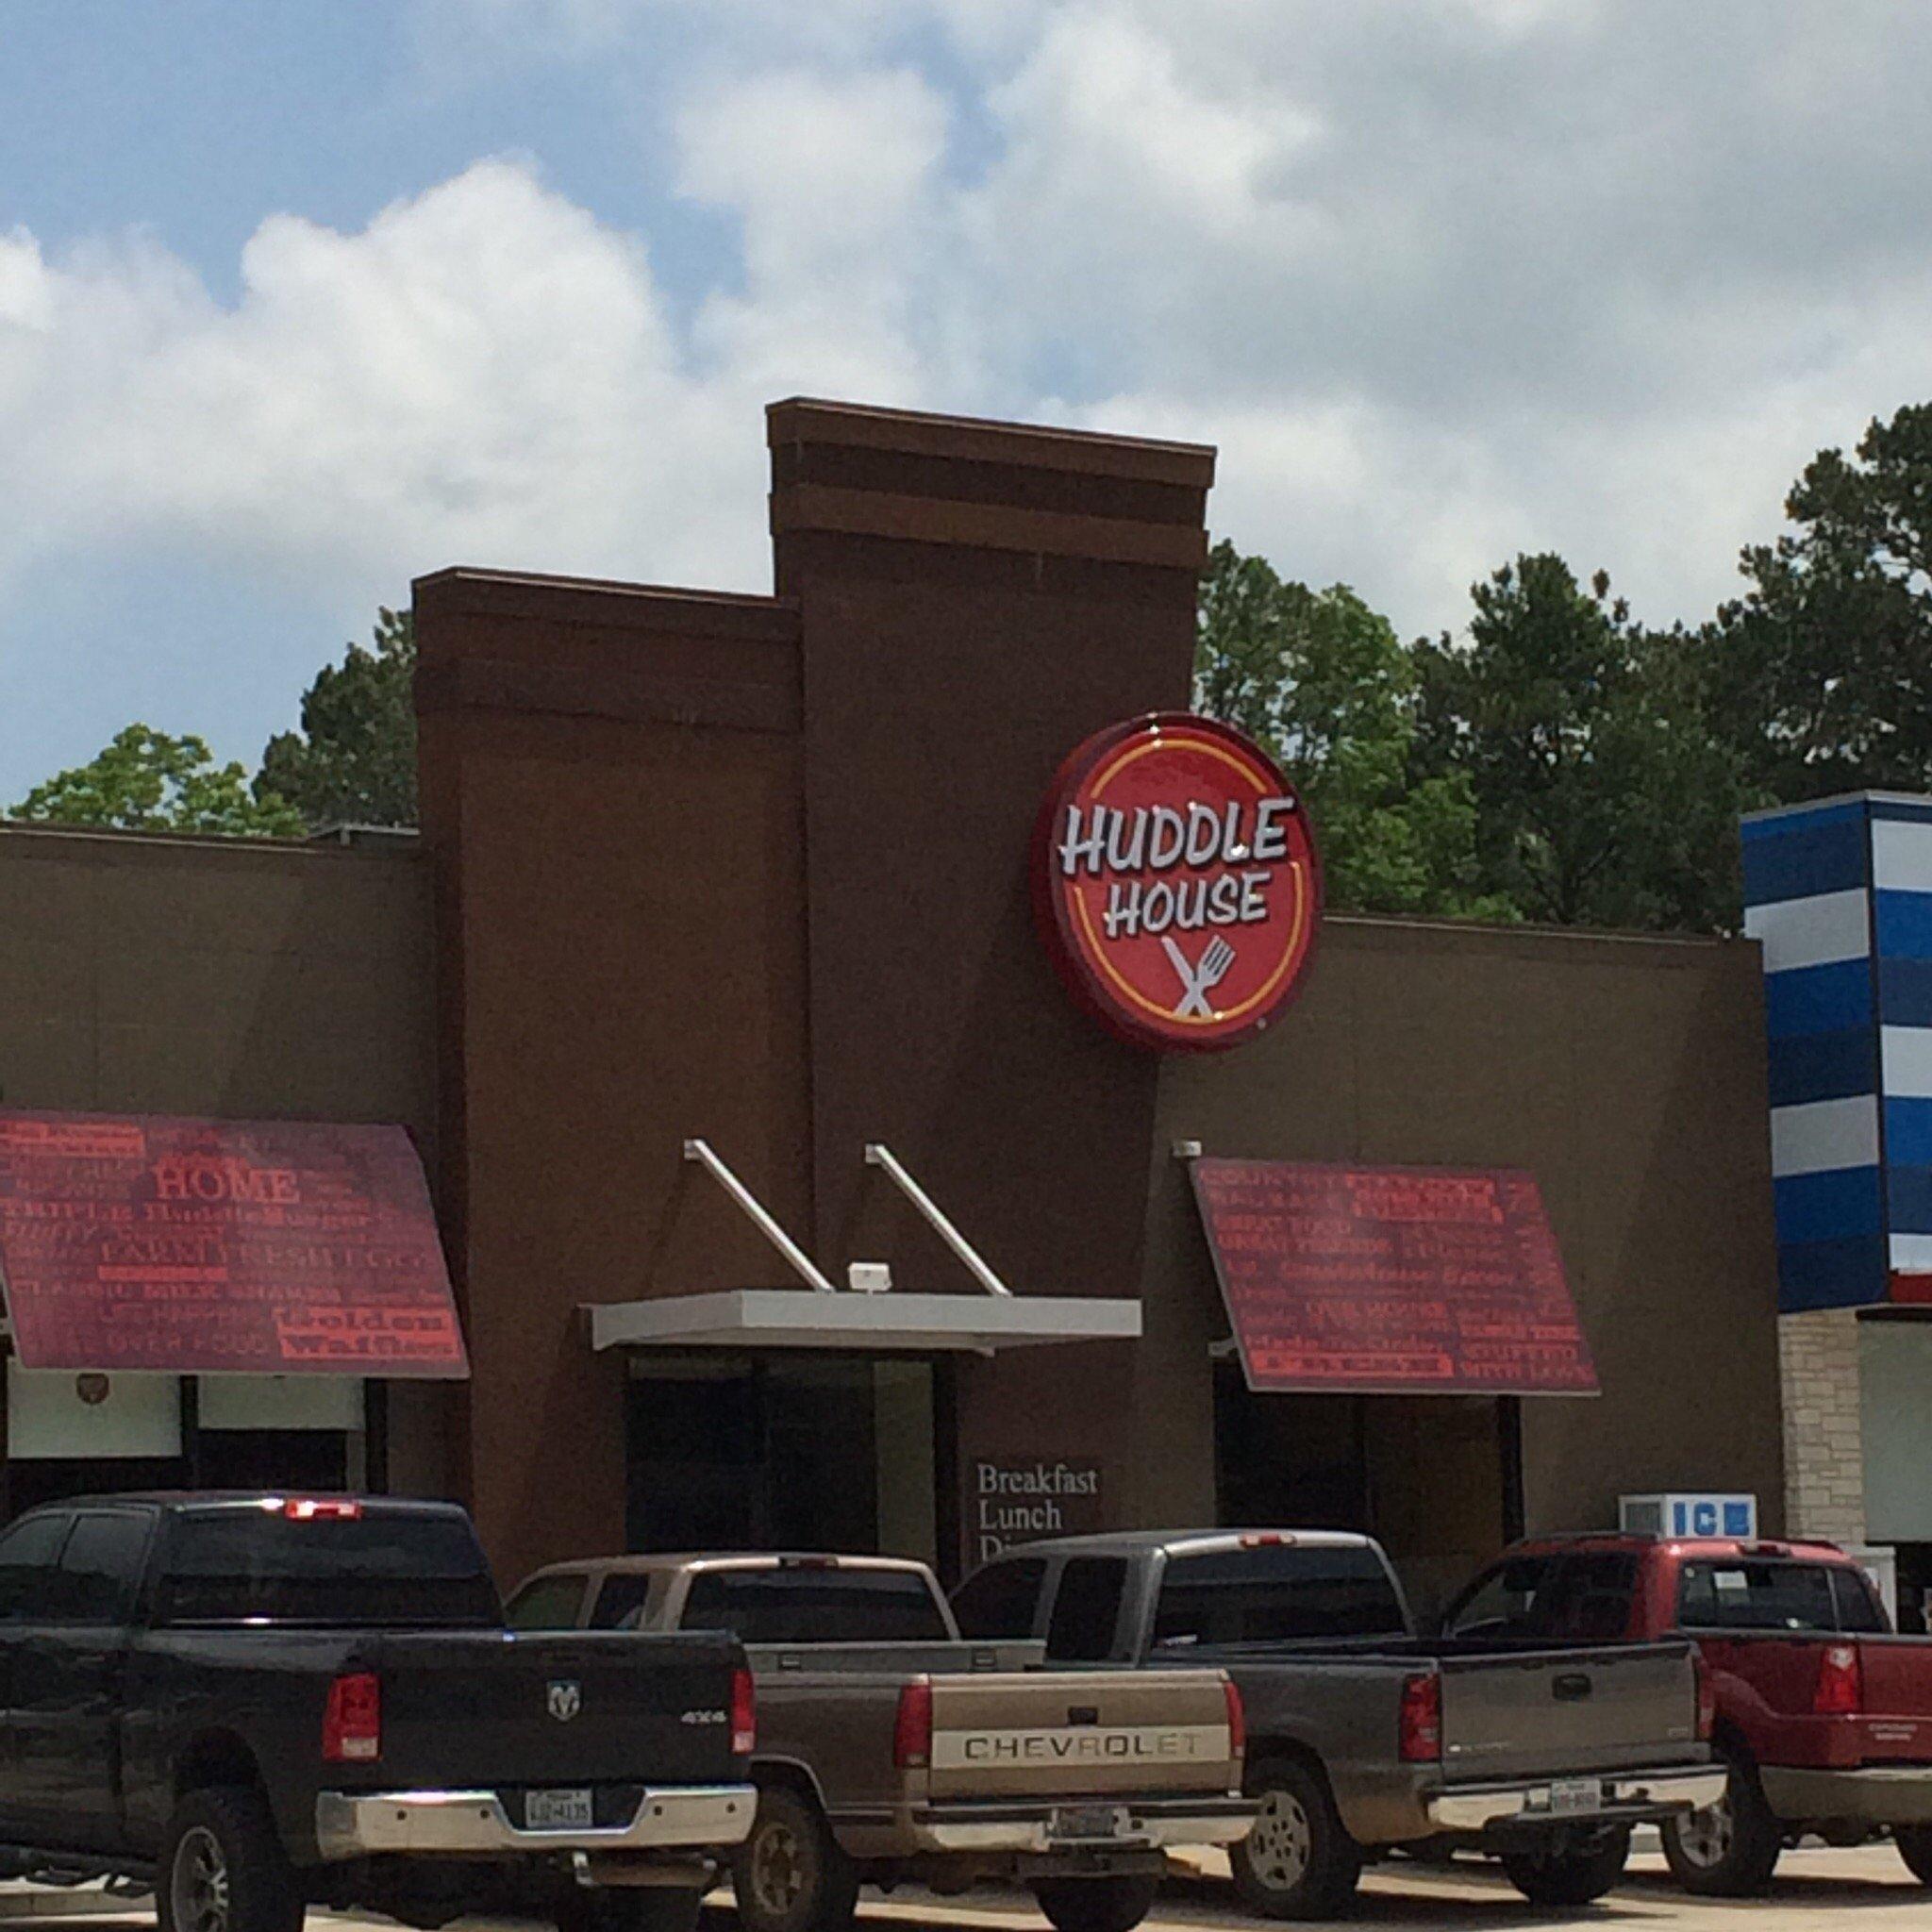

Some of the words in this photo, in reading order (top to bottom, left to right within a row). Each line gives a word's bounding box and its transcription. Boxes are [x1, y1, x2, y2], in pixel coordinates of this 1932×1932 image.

[1058, 796, 1294, 874] HUDDLE
[1102, 872, 1271, 938] HOUSE
[154, 1165, 301, 1204] HOME
[977, 1463, 1099, 1494] Breakfast
[978, 1498, 1063, 1530] Lunch
[1673, 1501, 1751, 1537] ICE
[964, 1732, 1202, 1759] CHEVROLET
